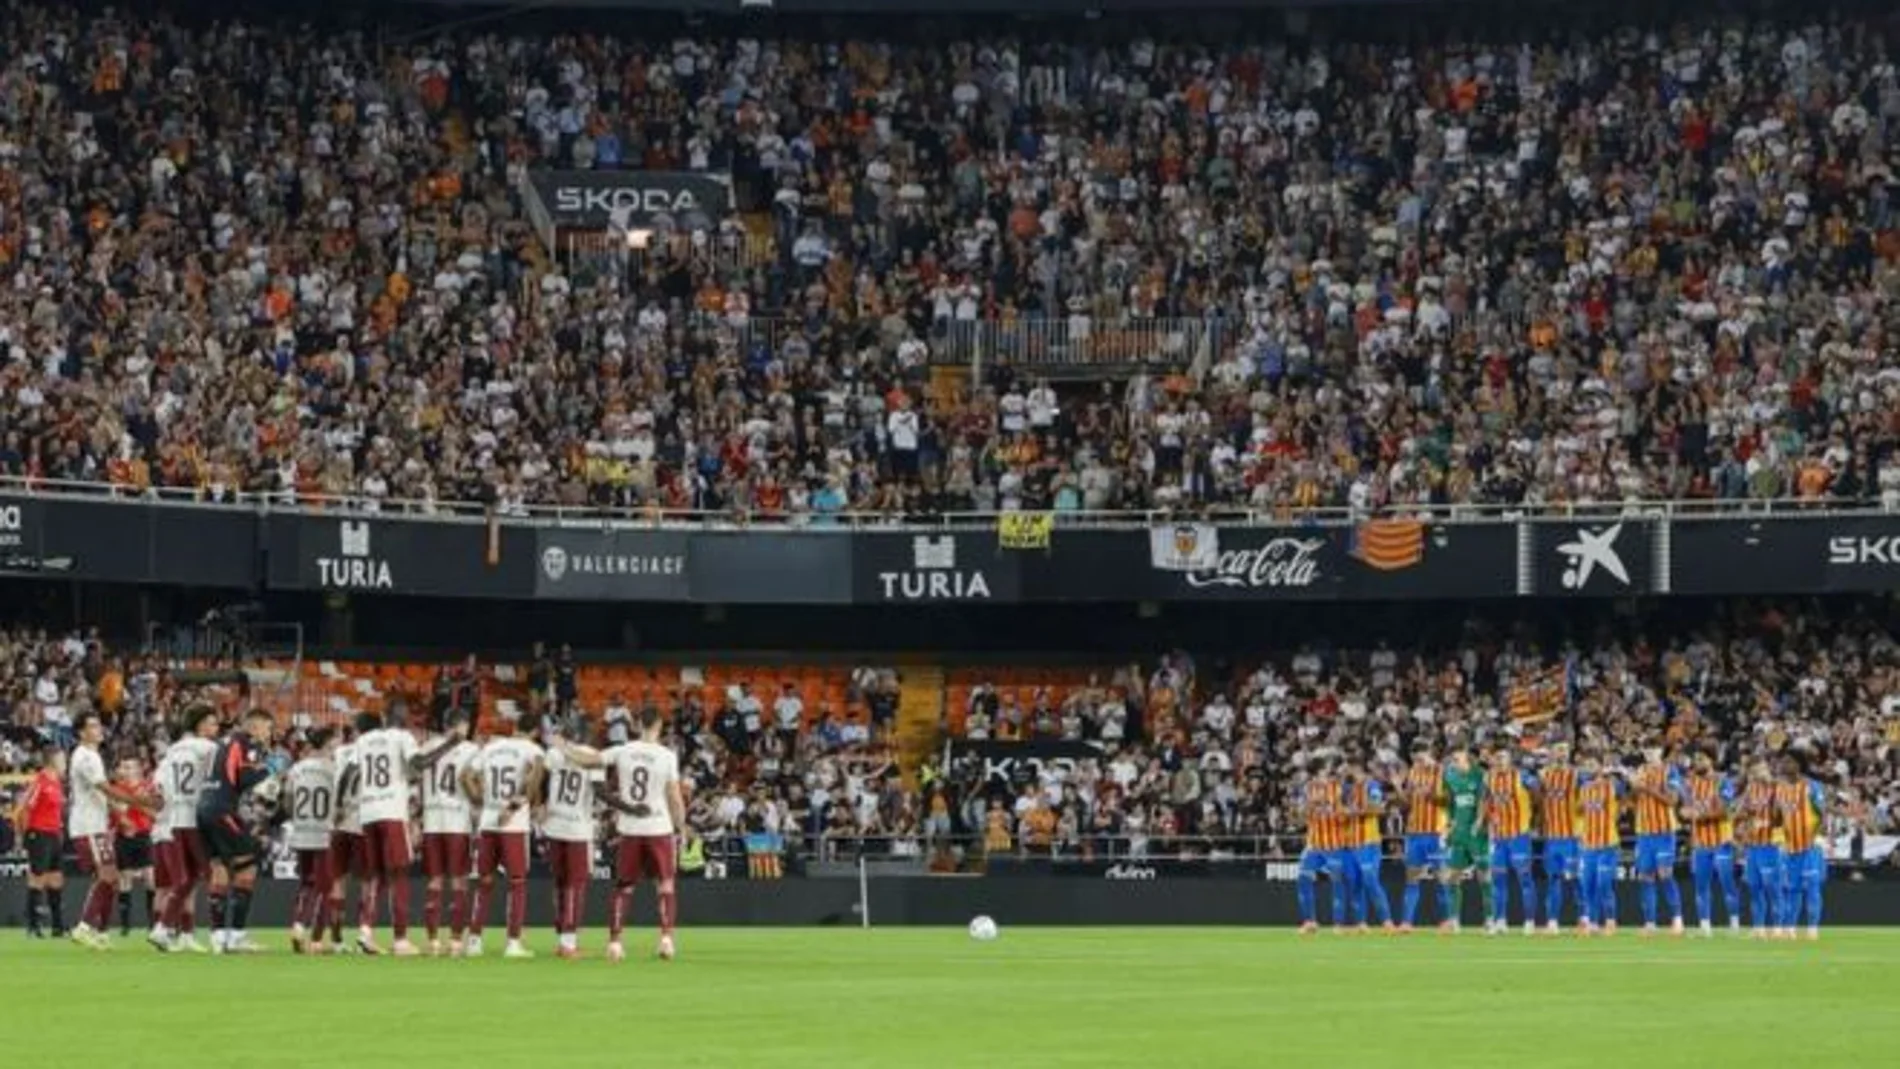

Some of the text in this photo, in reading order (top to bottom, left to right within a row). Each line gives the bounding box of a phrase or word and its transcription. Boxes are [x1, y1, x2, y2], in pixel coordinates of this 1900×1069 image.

[317, 558, 393, 589] TURIA
[880, 573, 990, 598] TURIA
[172, 761, 195, 796] 12
[365, 753, 390, 788] 18
[431, 761, 456, 796] 14
[491, 765, 515, 799] 15
[556, 768, 582, 806] 19
[629, 766, 648, 802] 8
[295, 785, 330, 820] 20
